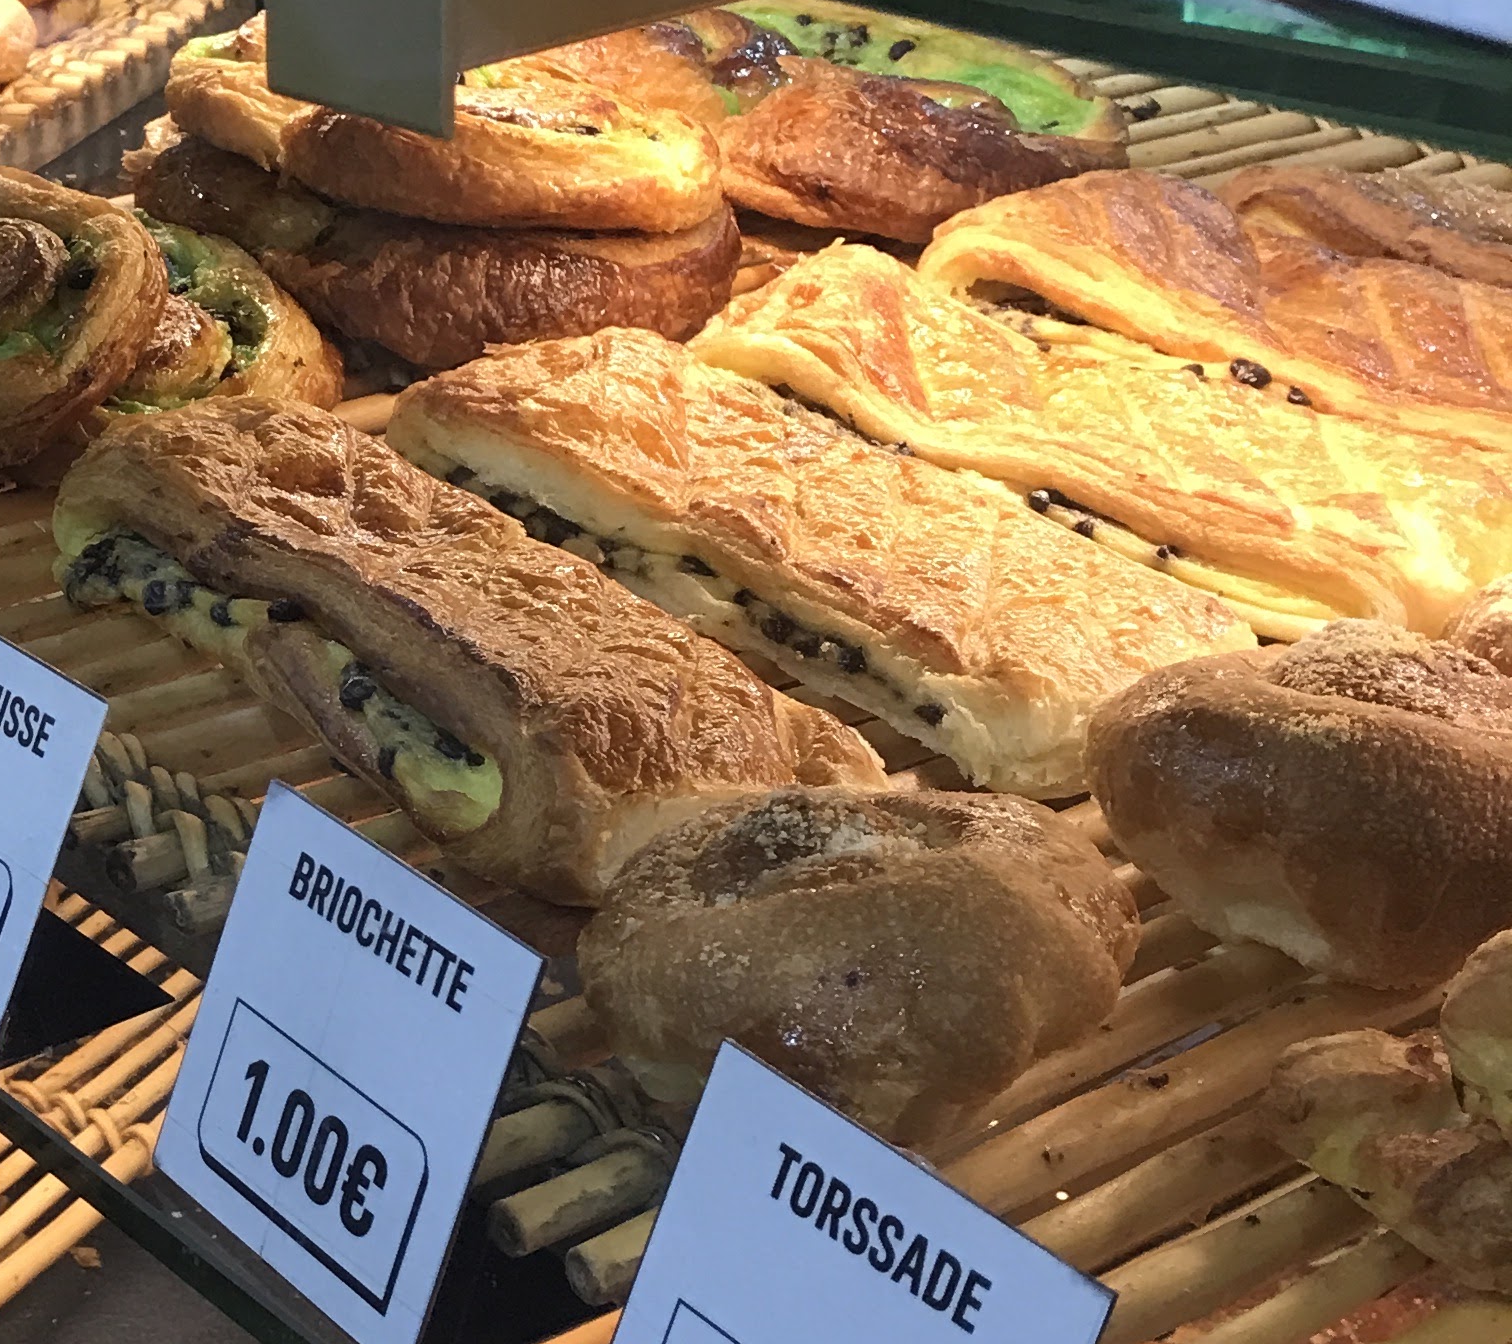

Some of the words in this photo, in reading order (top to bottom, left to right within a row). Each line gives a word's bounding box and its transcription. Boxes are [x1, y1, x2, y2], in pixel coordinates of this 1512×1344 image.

[288, 851, 475, 1013] BRIOCHETTE
[236, 1060, 388, 1238] 1.00€
[769, 1142, 994, 1335] TORSSADE
